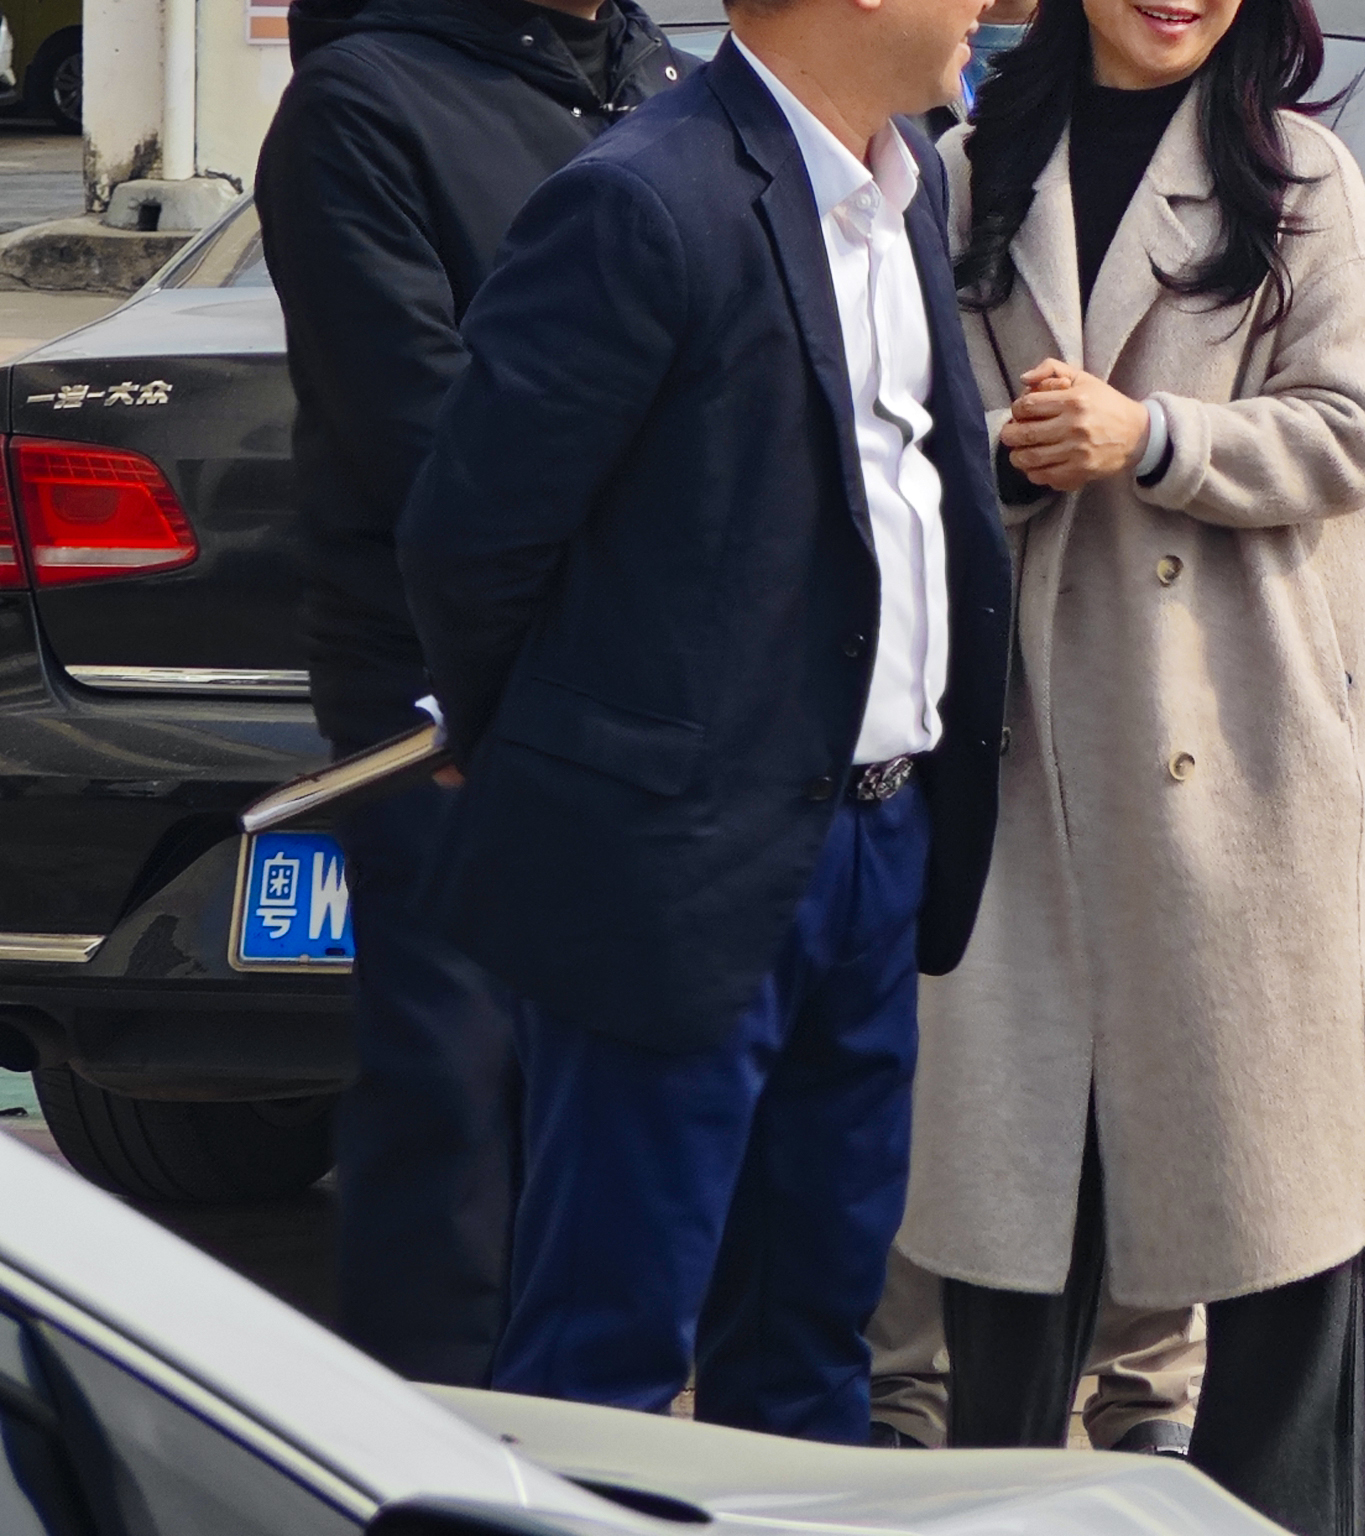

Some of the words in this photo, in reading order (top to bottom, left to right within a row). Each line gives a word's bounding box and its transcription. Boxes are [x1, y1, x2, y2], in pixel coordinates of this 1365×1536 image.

[26, 380, 174, 411] 一汽-大众
[255, 850, 350, 941] 粤W
